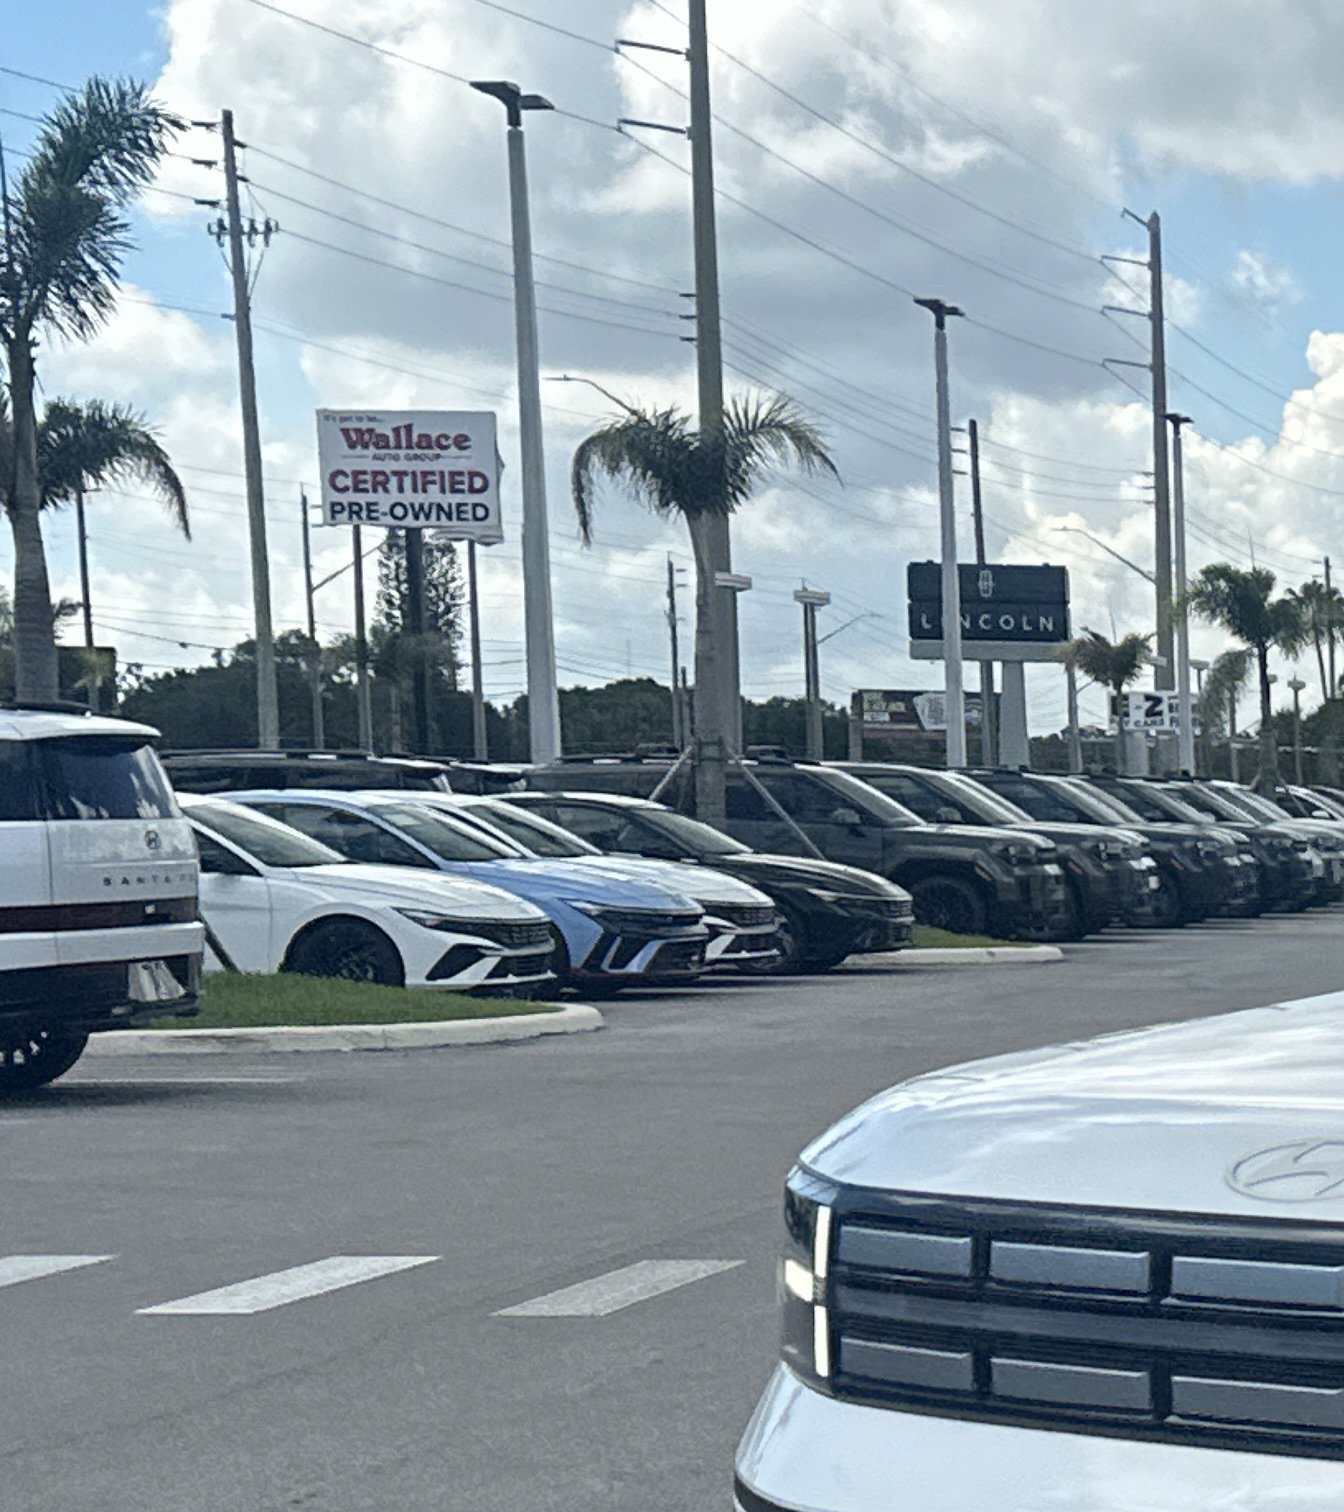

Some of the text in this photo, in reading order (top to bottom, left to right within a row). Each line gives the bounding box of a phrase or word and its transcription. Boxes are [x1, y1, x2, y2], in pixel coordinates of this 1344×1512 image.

[340, 422, 472, 450] Wallace
[371, 452, 442, 462] AUTO GROUP
[328, 469, 490, 495] CERTIFIED
[329, 501, 491, 522] PRE-OWNED
[921, 613, 1054, 632] LNCOLN
